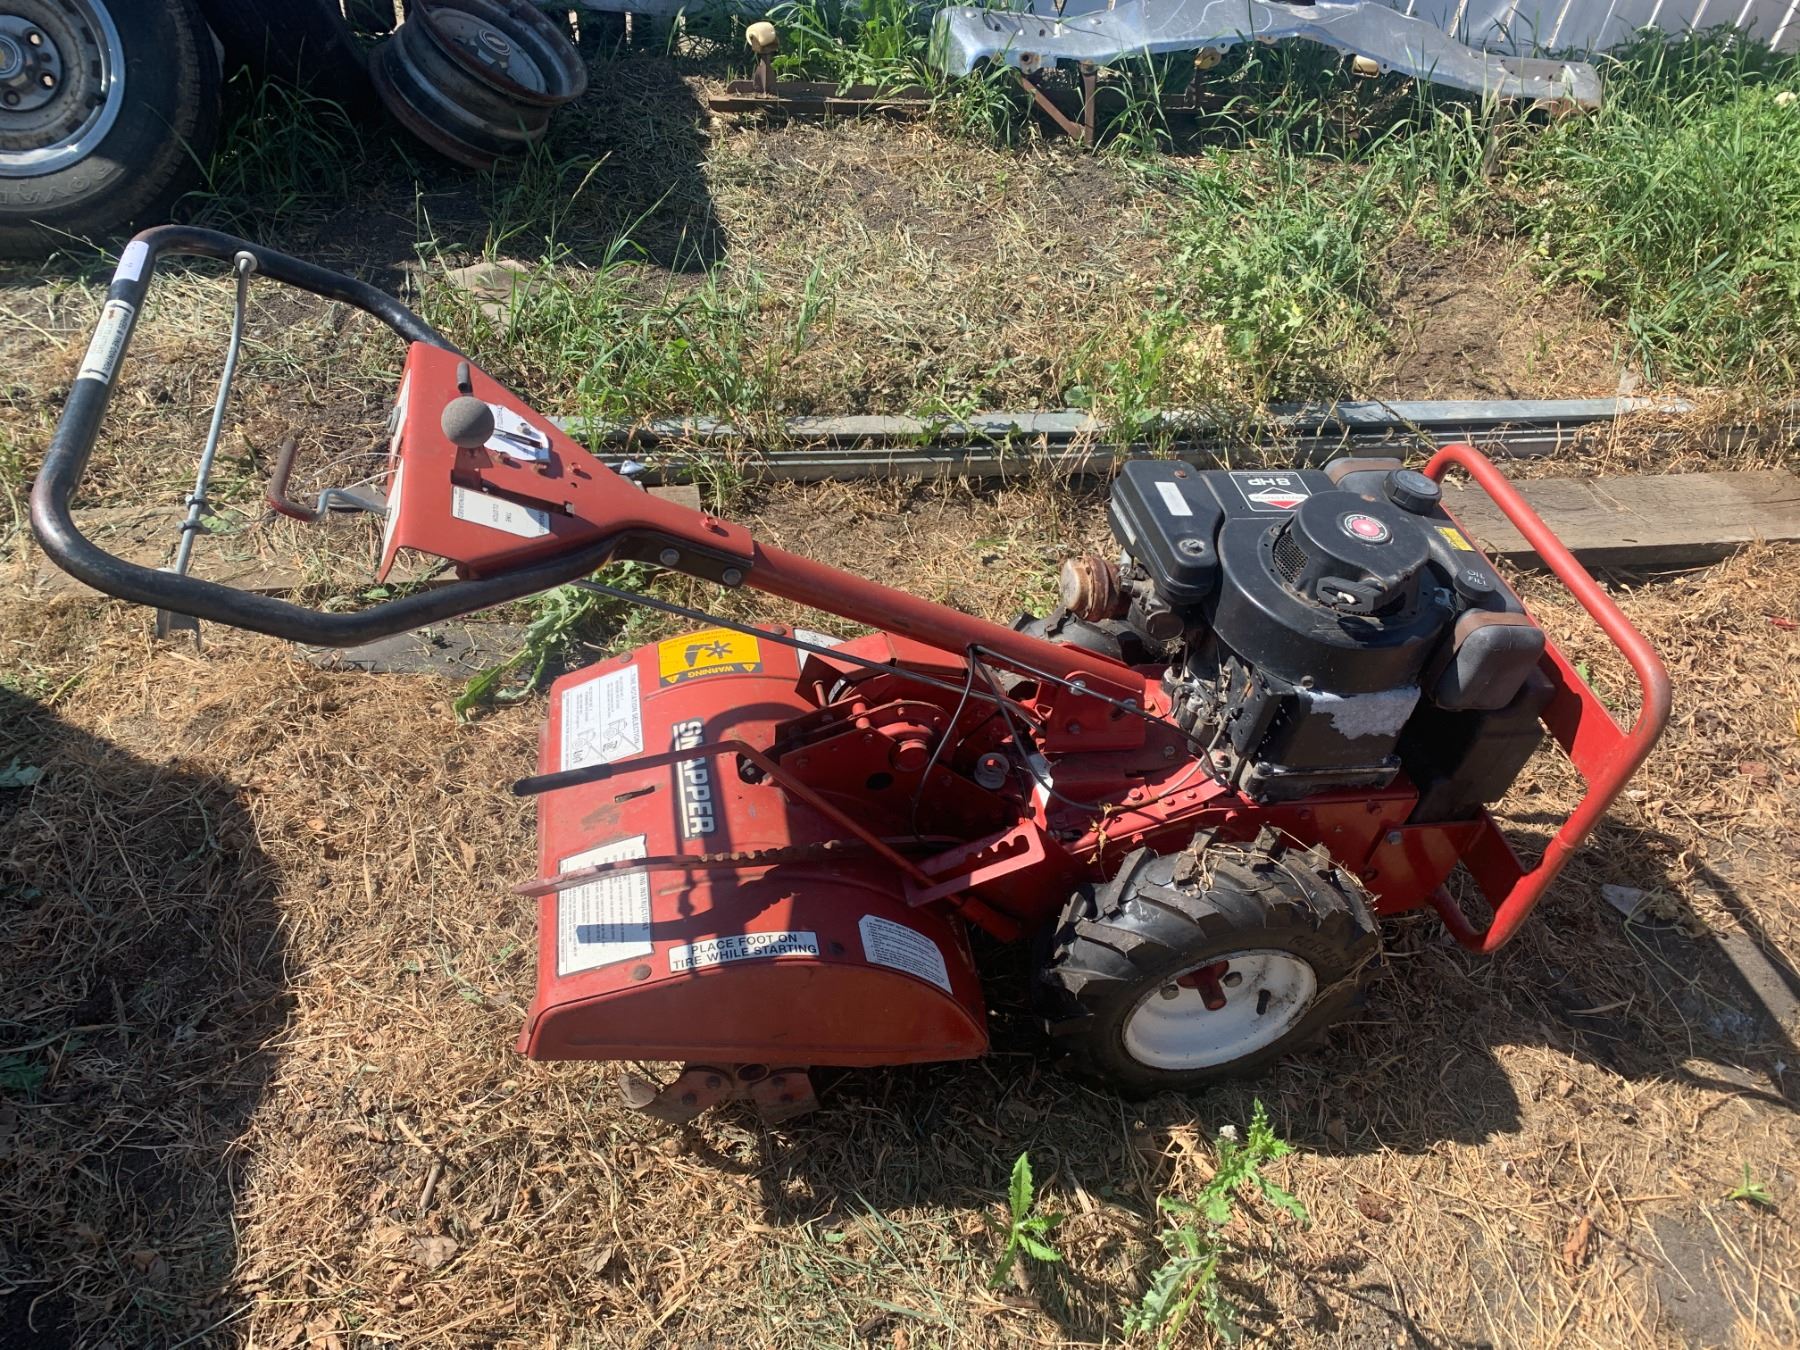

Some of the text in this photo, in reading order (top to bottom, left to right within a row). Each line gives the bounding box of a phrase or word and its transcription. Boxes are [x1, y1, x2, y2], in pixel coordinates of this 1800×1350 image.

[1467, 570, 1485, 580] OIL
[687, 665, 735, 678] WARNING
[632, 713, 640, 744] SELECTION
[679, 720, 715, 833] SNAPPER
[691, 934, 797, 954] PLACE FOOT ON
[673, 944, 817, 969] TIRE WHILE STARTING
